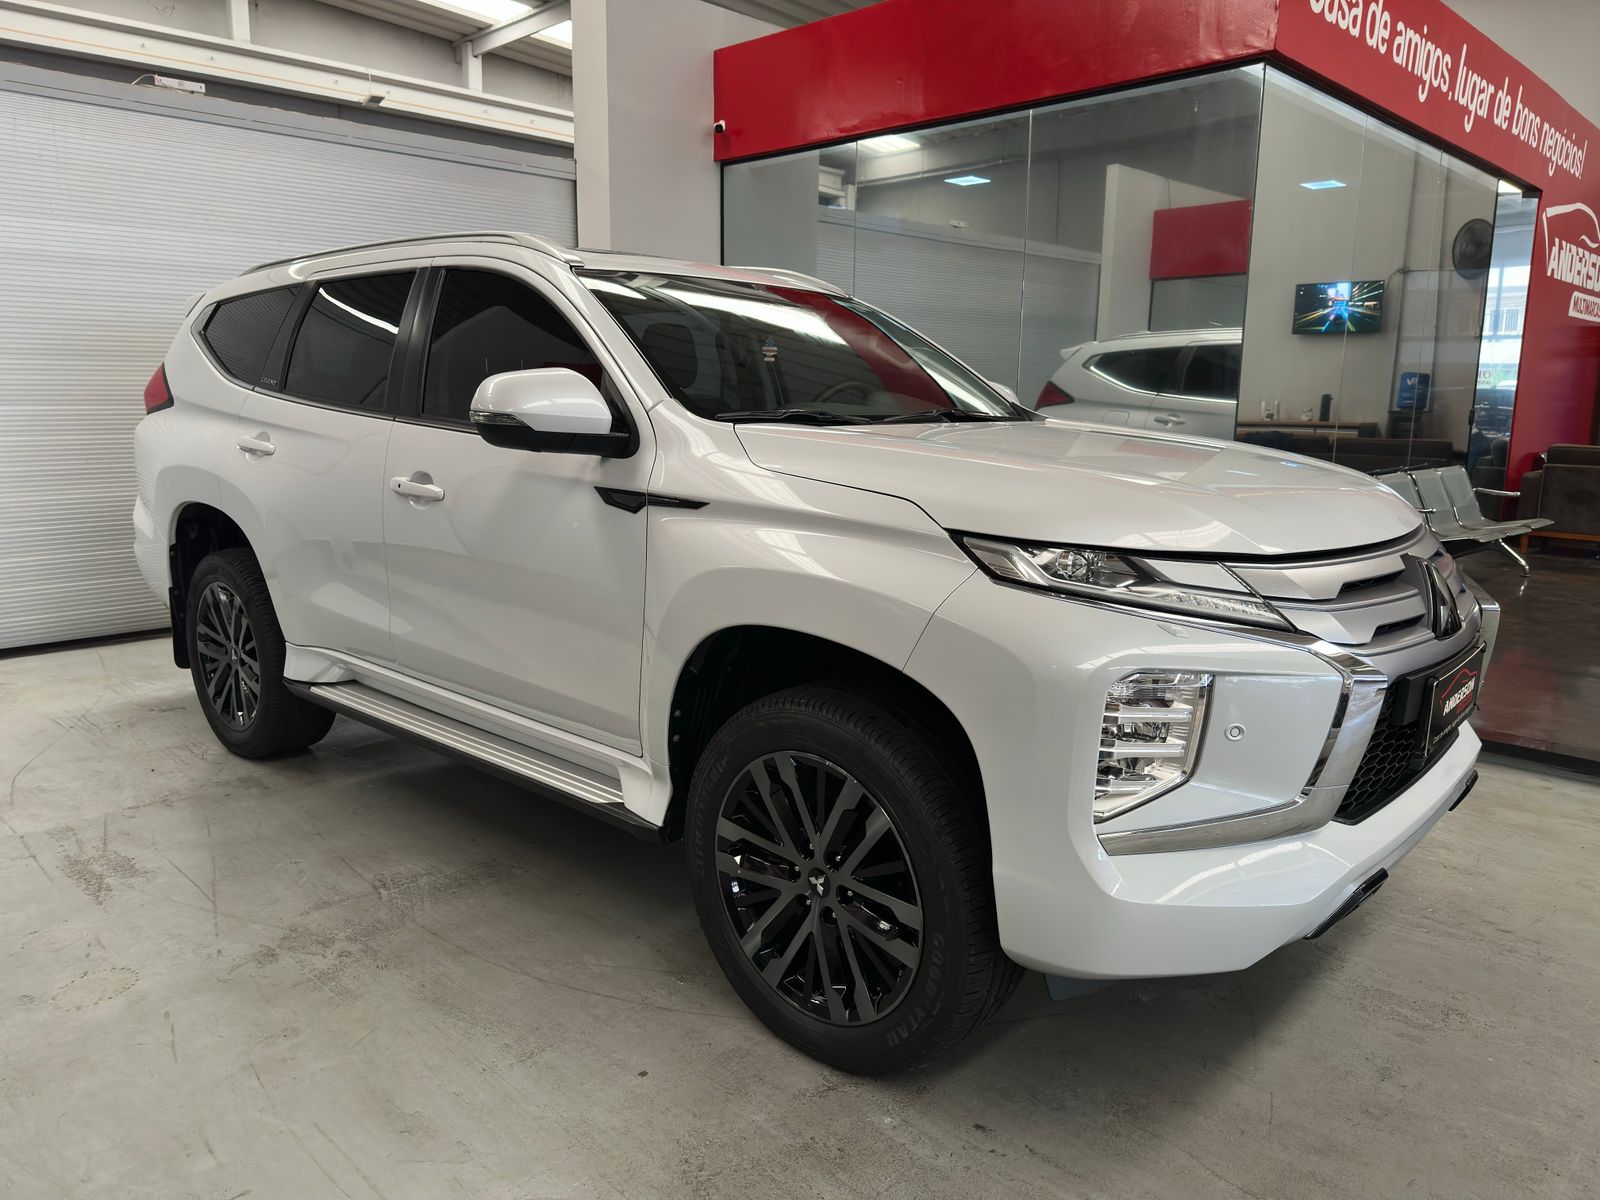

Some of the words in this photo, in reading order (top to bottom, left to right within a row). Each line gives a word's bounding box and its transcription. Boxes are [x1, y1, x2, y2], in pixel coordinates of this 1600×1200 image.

[1365, 0, 1391, 54] de
[1392, 21, 1453, 103] amigos,
[1454, 43, 1495, 133] lugar
[1493, 76, 1512, 130] de
[1511, 84, 1541, 149] bons
[1539, 121, 1588, 180] negócios!
